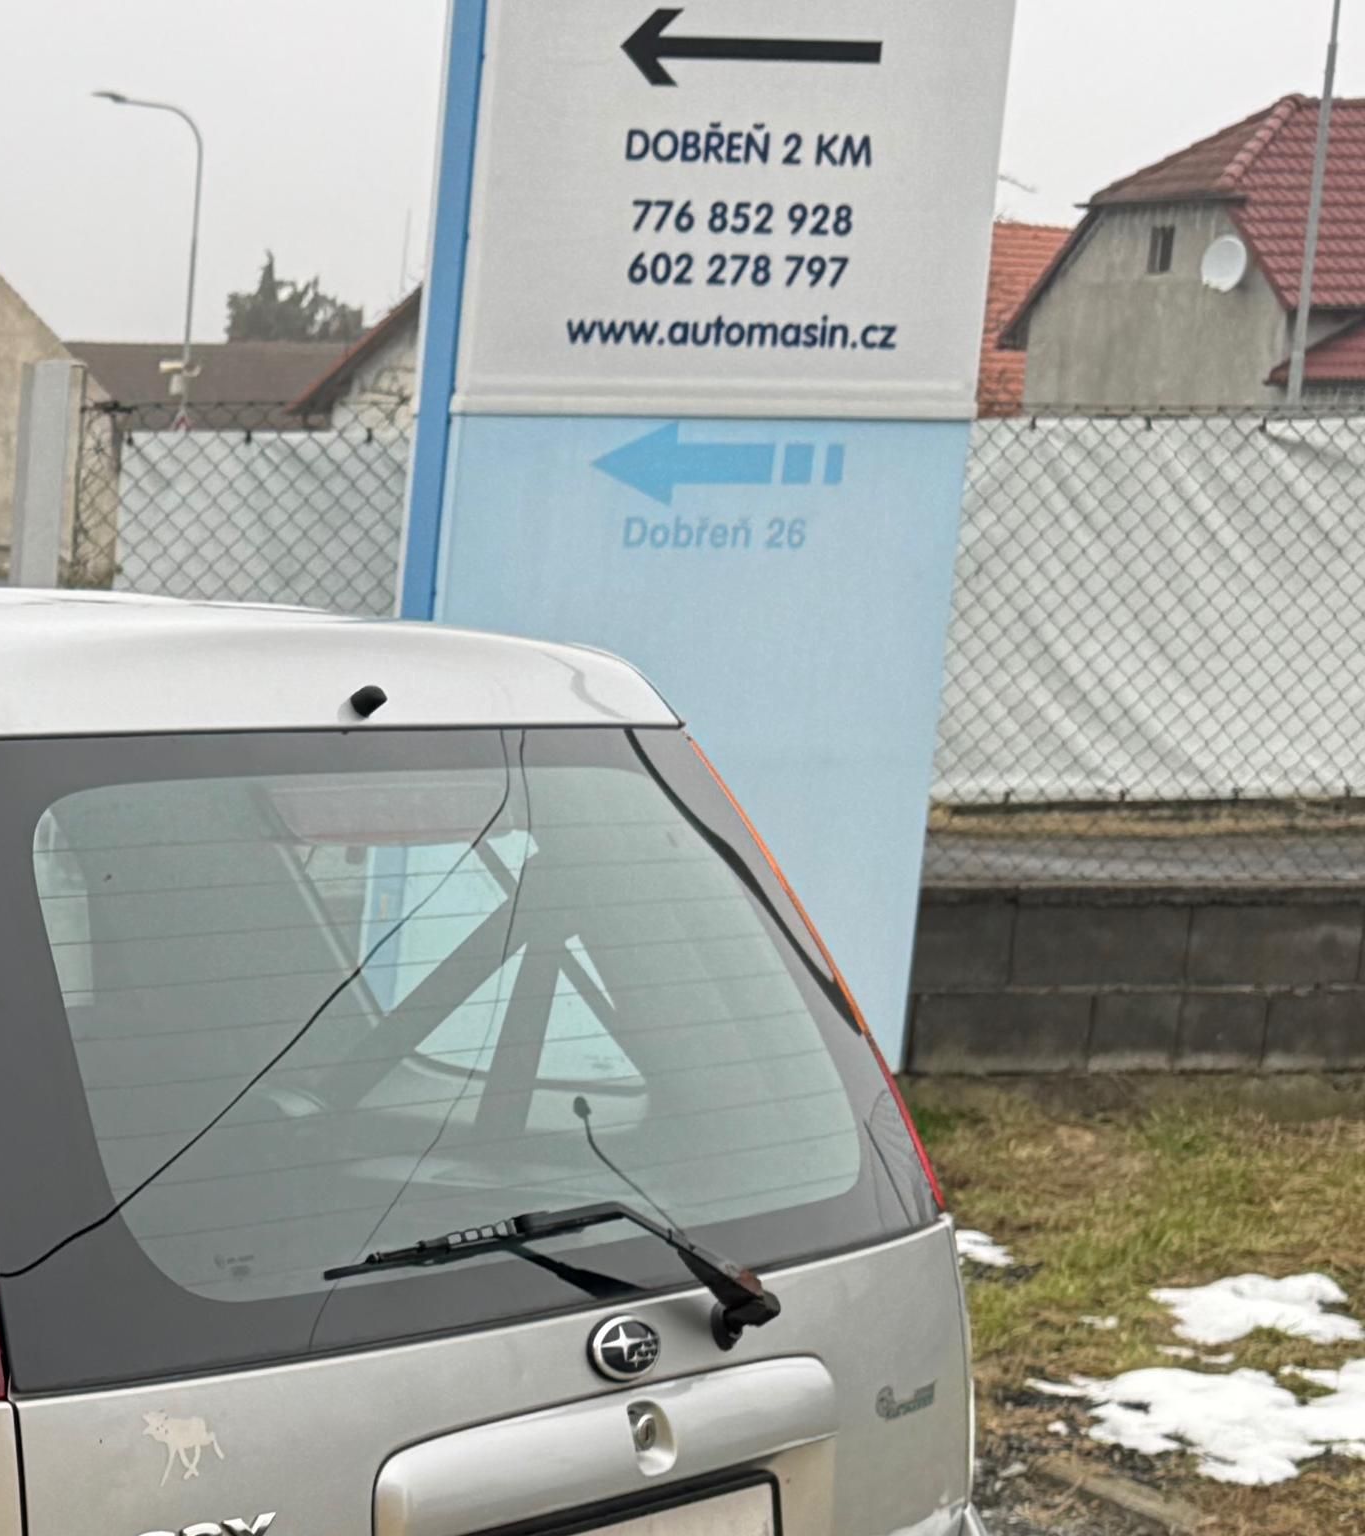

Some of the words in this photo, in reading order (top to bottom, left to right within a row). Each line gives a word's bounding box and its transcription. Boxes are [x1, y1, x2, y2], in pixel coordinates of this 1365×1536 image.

[625, 121, 771, 166] DOBŘEŇ
[782, 132, 804, 166] 2
[815, 133, 873, 168] KM
[632, 199, 695, 234] 776
[707, 200, 774, 236] 852
[787, 202, 853, 237] 928
[627, 251, 694, 285] 602
[706, 253, 771, 287] 278
[785, 255, 849, 289] 797
[566, 314, 897, 350] www.automasin.cz
[622, 515, 753, 549] Dobřeň
[764, 516, 807, 550] 26
